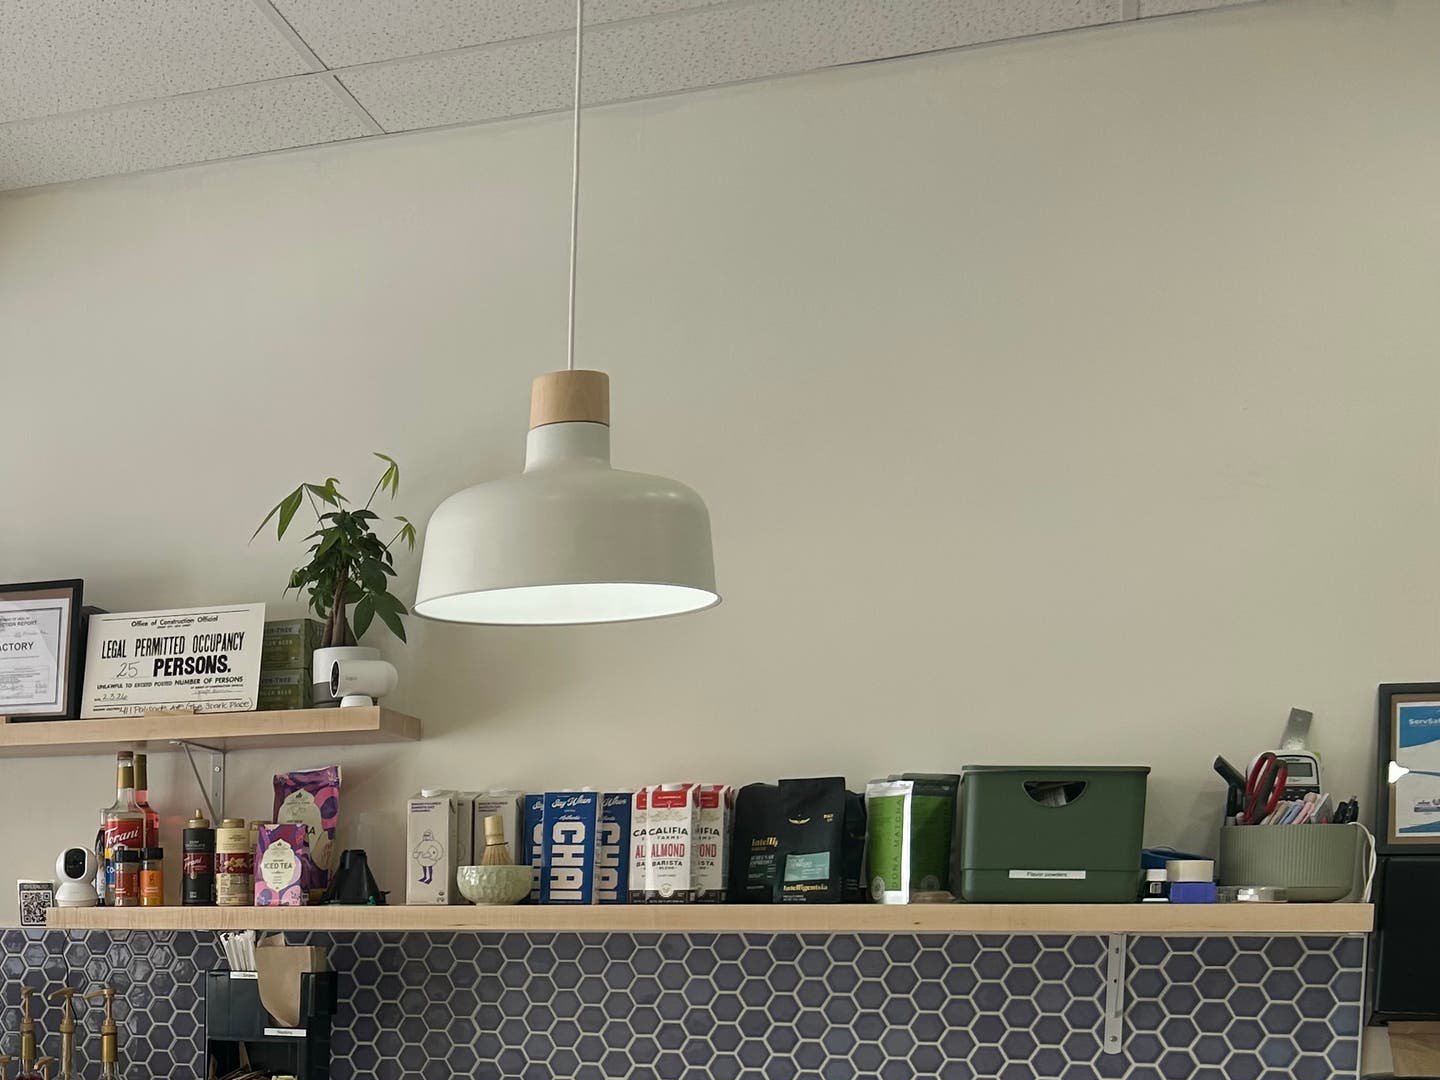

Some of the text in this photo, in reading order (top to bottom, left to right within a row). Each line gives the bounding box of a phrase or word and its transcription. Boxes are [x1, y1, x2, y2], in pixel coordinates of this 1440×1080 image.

[160, 617, 195, 626] Construction
[101, 631, 246, 659] LEGAL PERMITTED OCCUPANCY
[116, 654, 232, 678] 25 PERSONS.
[174, 678, 201, 686] NUMBER
[214, 676, 244, 684] PERSONS
[105, 826, 139, 849] Torani
[648, 826, 689, 836] CALIFIA
[650, 843, 686, 858] ALMOND
[263, 862, 293, 870] ICED TEA
[549, 821, 586, 900] CHAI
